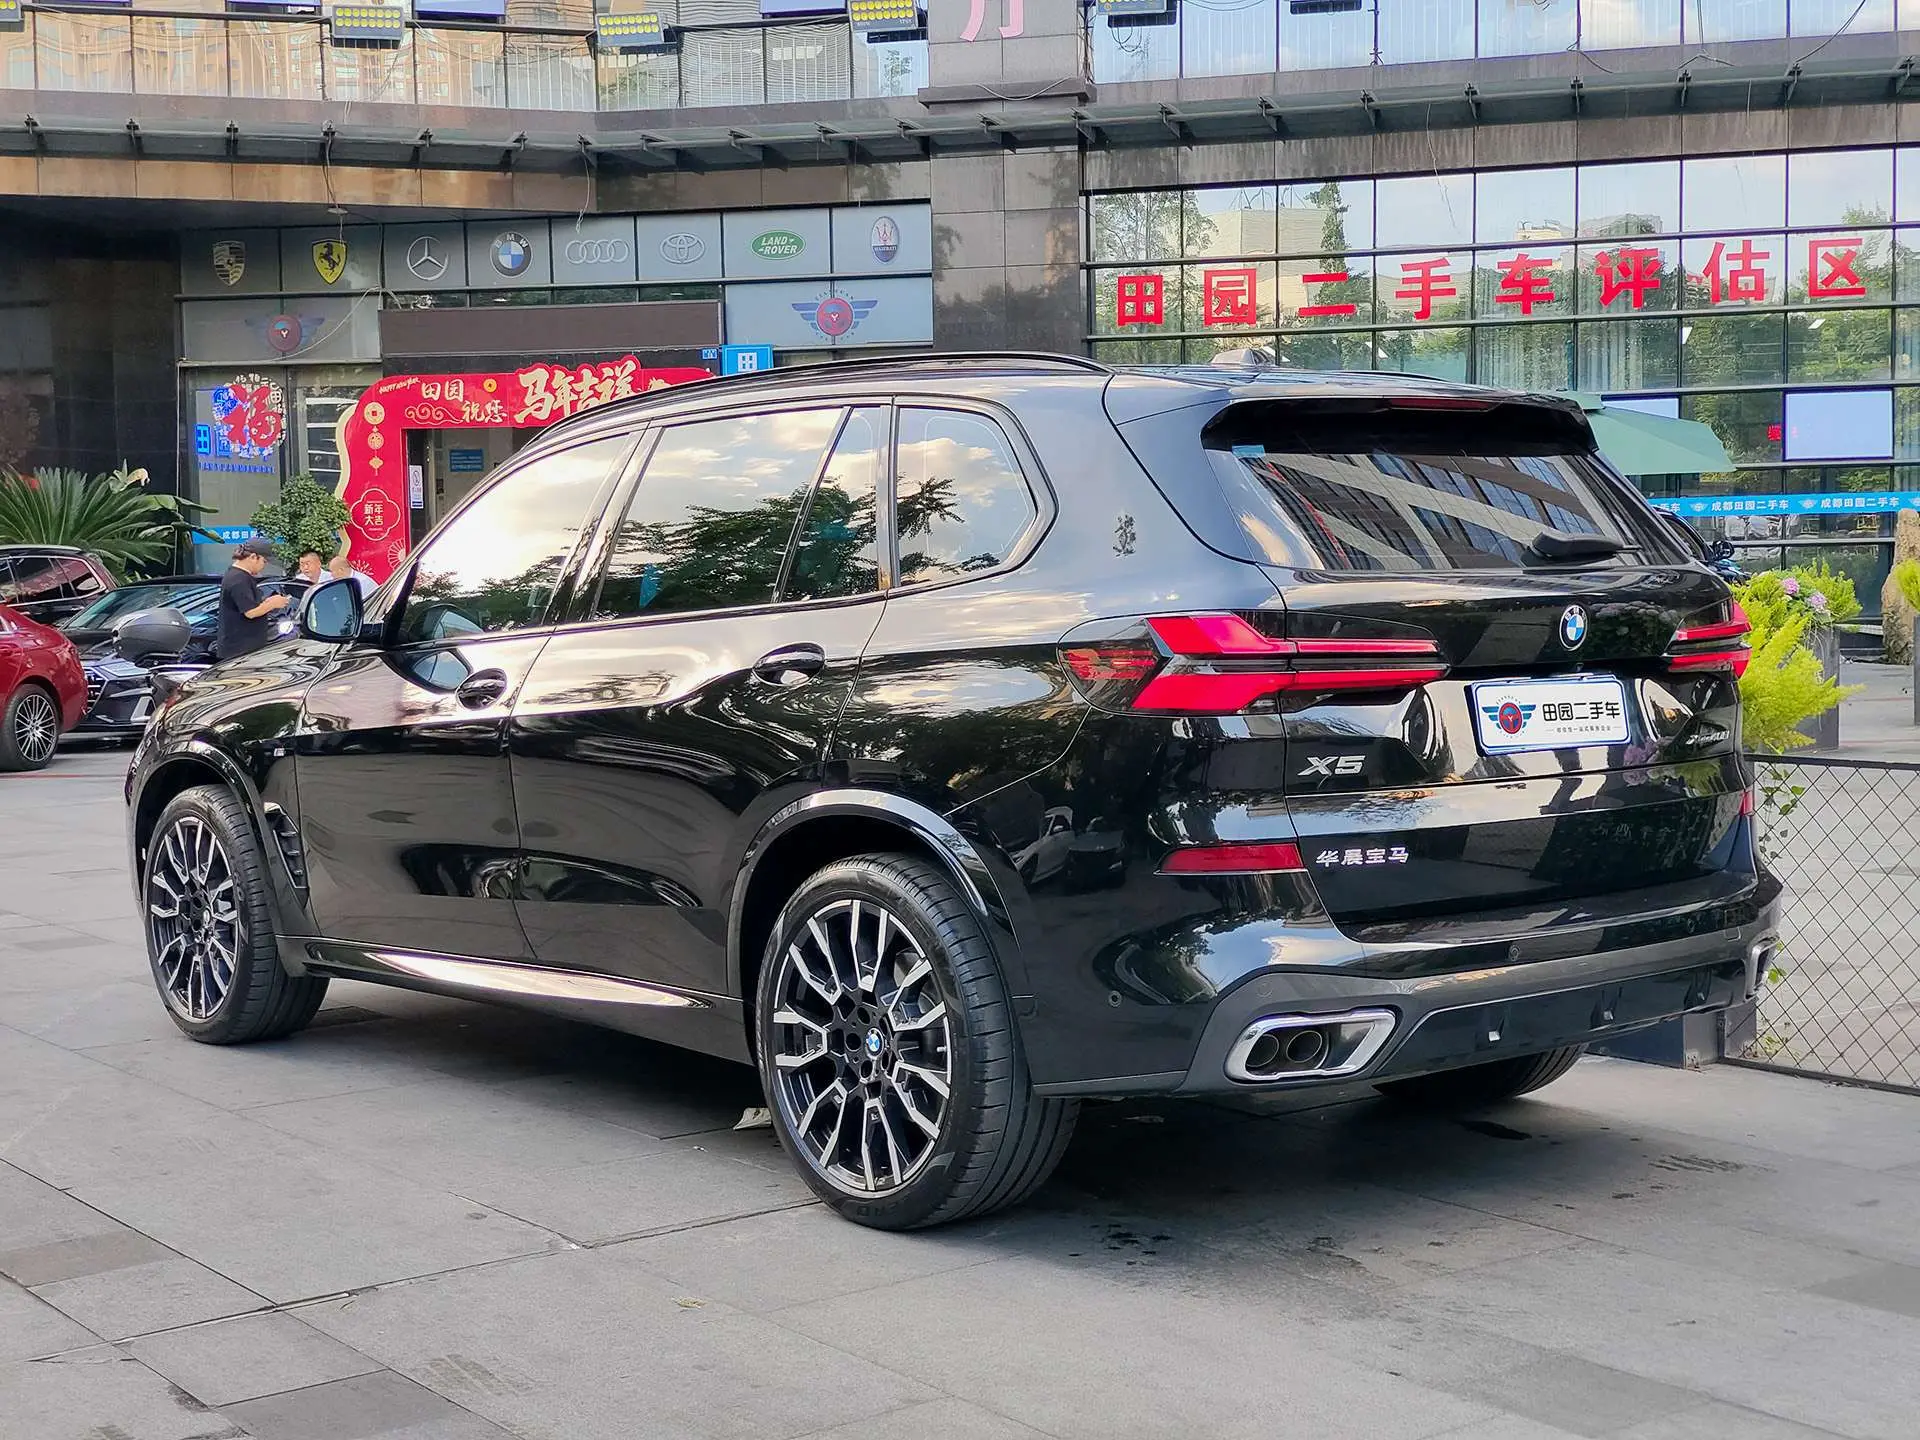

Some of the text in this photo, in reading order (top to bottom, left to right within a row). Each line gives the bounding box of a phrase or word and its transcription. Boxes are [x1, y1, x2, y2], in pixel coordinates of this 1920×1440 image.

[495, 233, 528, 249] BMW
[761, 236, 789, 246] LAND
[764, 245, 798, 255] ROVER
[1117, 238, 1867, 327] 田园二手车评估区
[421, 379, 464, 402] 田园
[514, 359, 637, 424] 马年吉祥
[461, 400, 507, 424] 祝您
[364, 503, 384, 515] 新年
[1711, 499, 1789, 512] 成都田园二手车
[1821, 497, 1899, 509] 成都田园二手车
[364, 515, 384, 526] 大吉
[1542, 701, 1621, 722] 田园二手车
[1297, 755, 1366, 776] X5
[1315, 846, 1410, 868] 华晨宝马
